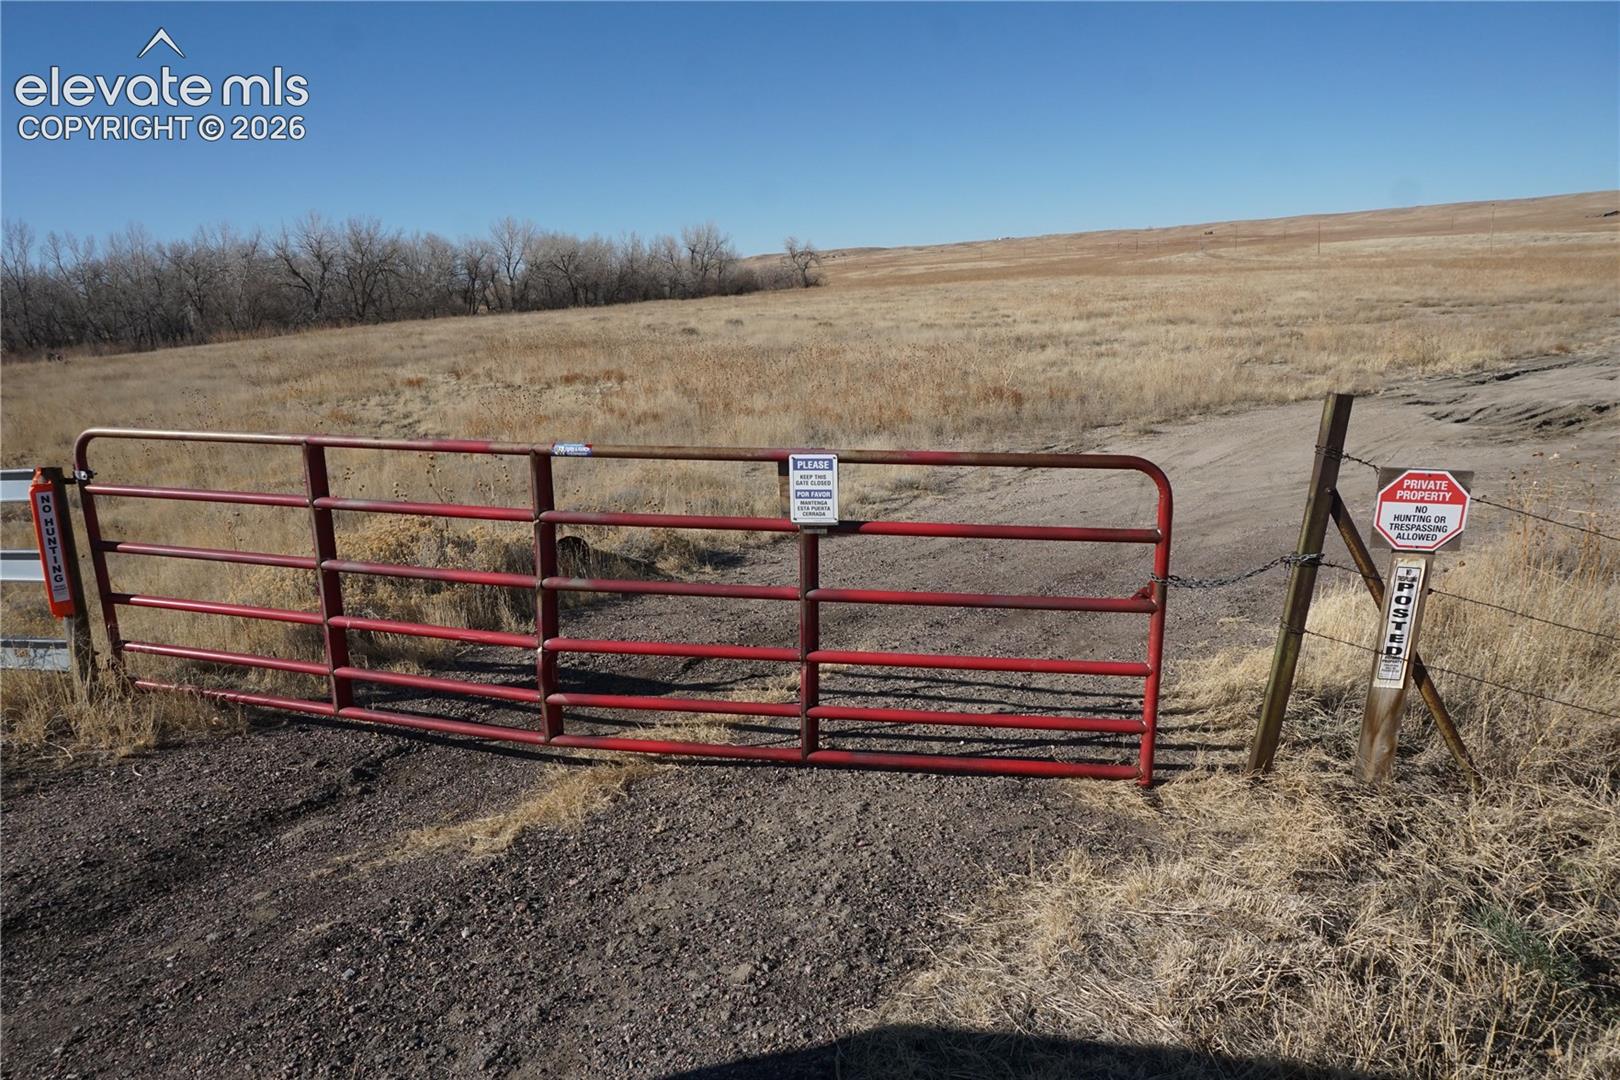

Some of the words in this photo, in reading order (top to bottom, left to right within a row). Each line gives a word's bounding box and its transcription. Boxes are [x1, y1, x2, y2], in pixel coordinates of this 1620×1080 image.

[797, 460, 830, 469] PLEASE
[1403, 479, 1448, 490] PRIVATE
[1396, 490, 1452, 502] PROPERTY
[40, 495, 52, 513] NO
[1414, 505, 1428, 514] NO
[1393, 514, 1431, 523] HUNTING
[1434, 515, 1446, 523] OR
[1389, 523, 1448, 533] TRESPASSING
[1395, 532, 1437, 541] ALLOWED
[44, 518, 64, 583] HUNTING
[1385, 582, 1414, 655] POSTED
